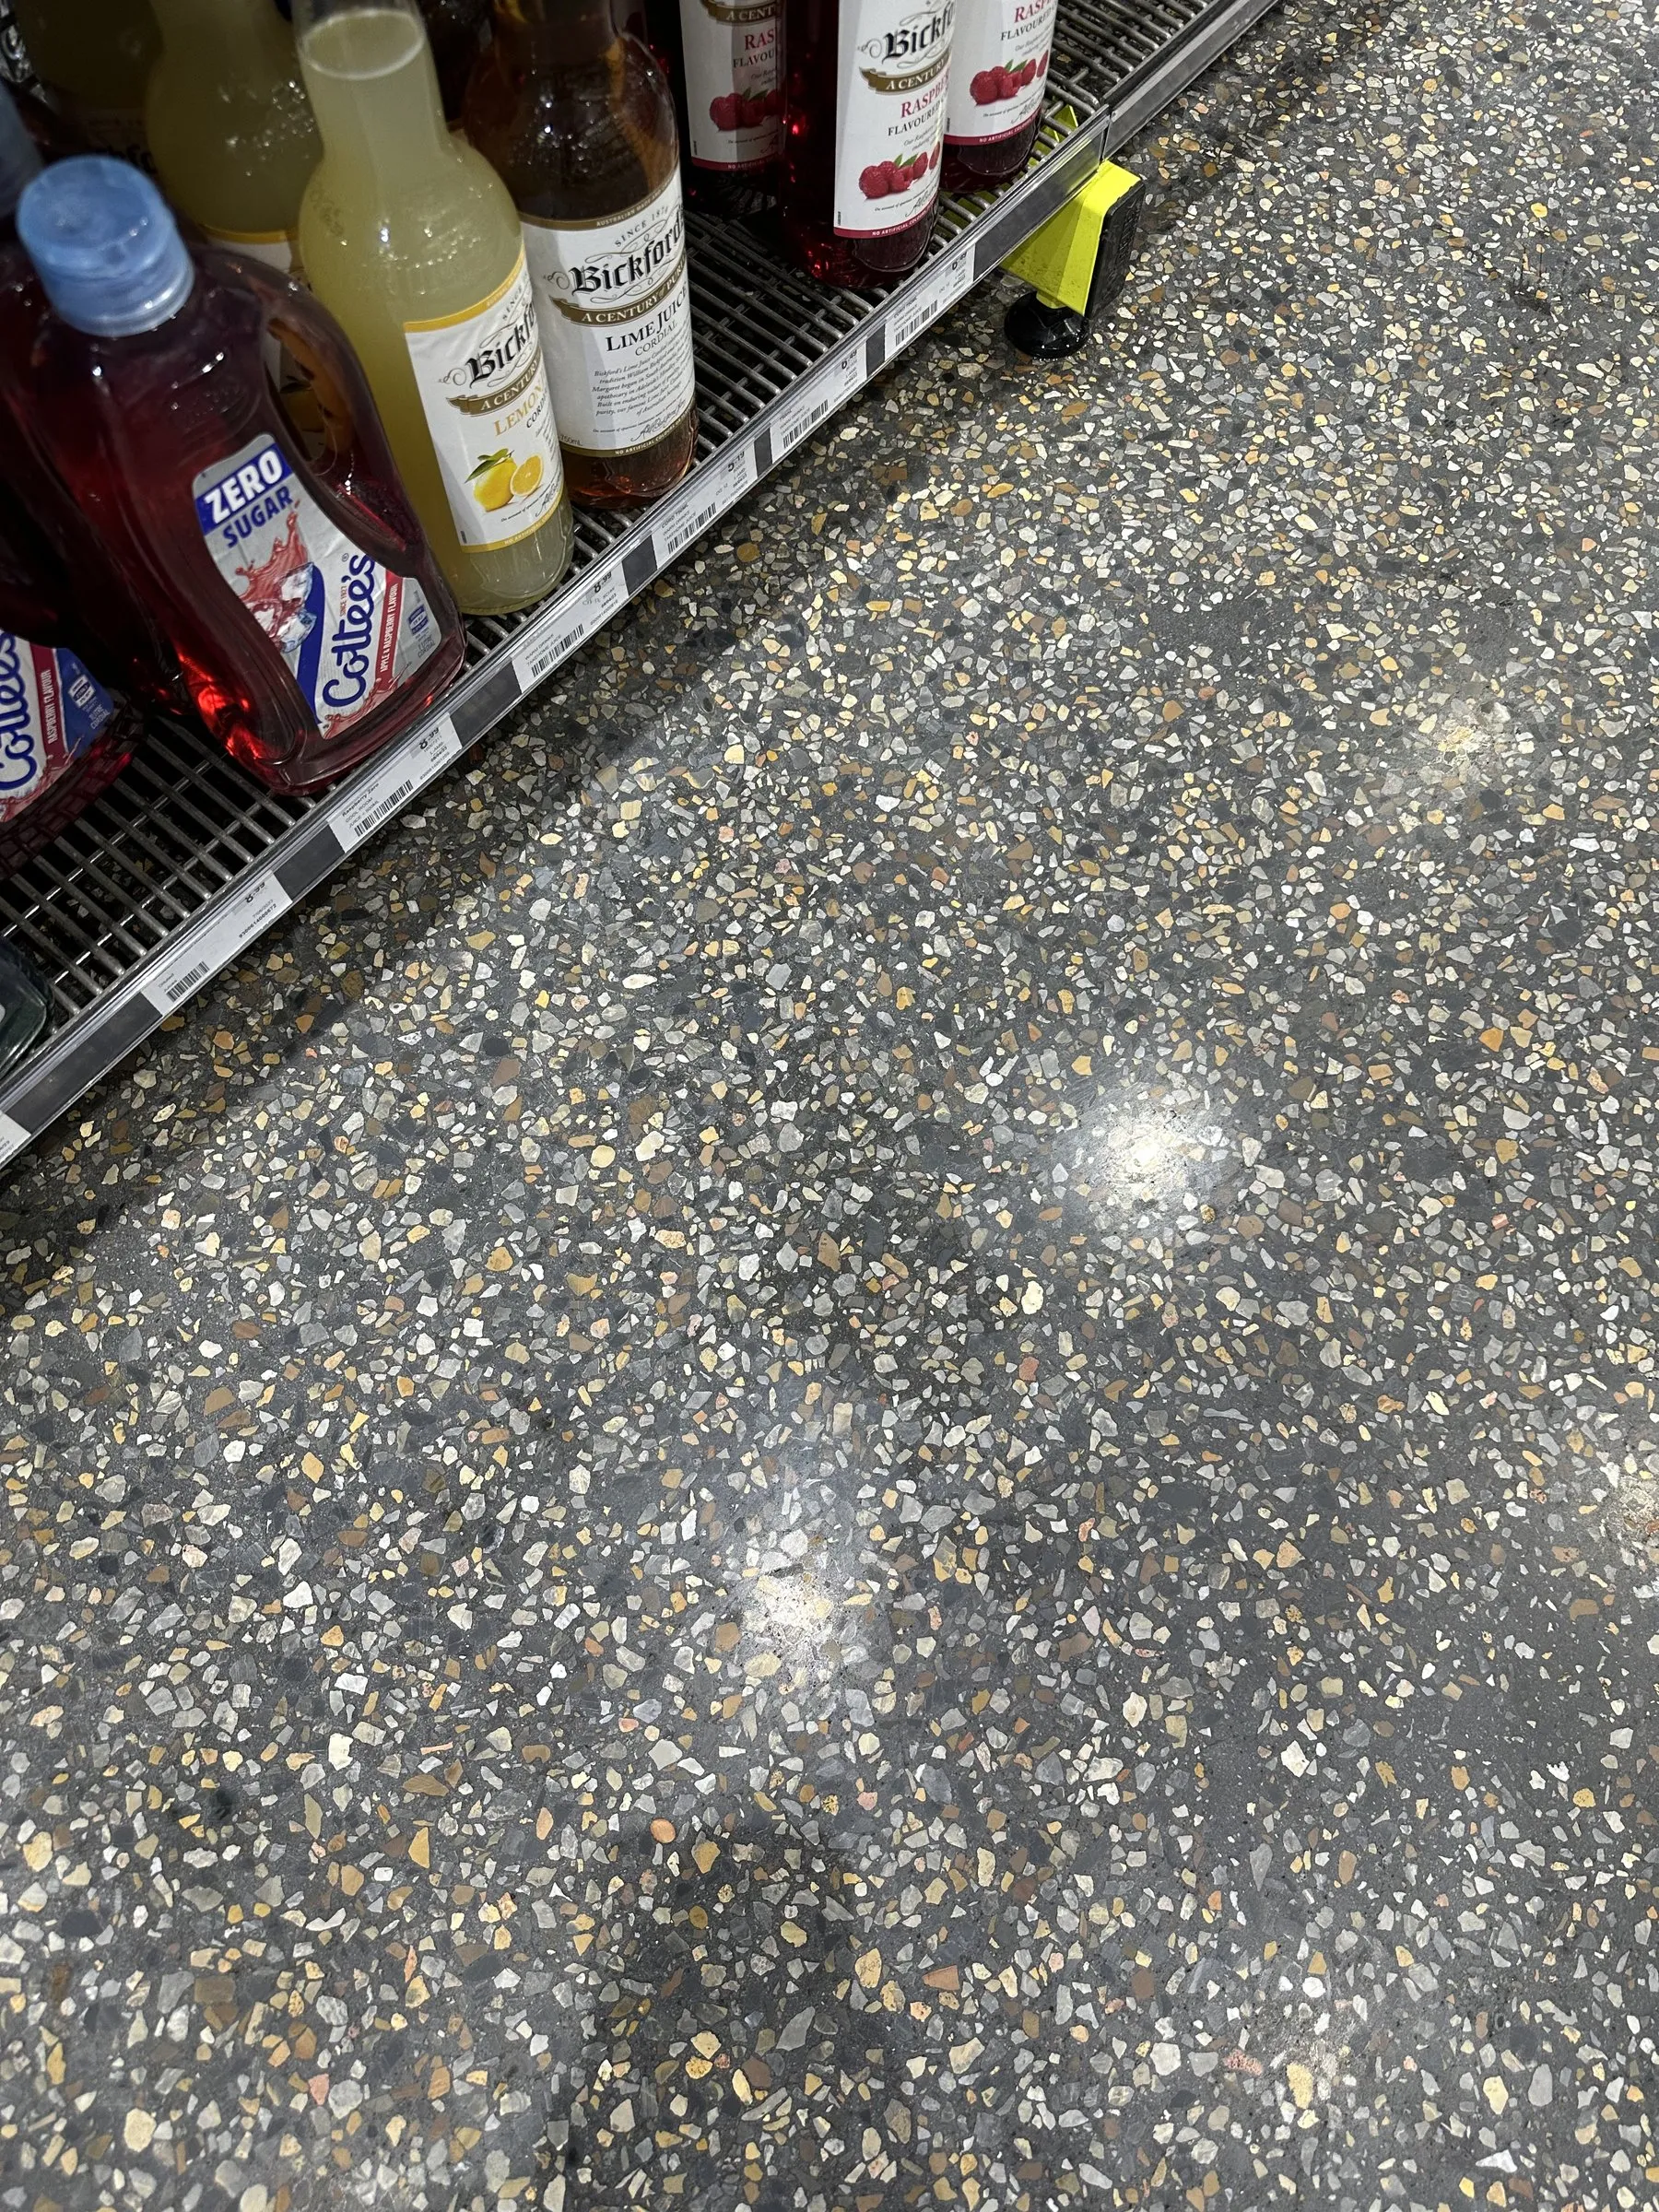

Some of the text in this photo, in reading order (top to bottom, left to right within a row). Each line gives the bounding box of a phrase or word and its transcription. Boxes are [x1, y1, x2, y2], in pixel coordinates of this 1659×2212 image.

[726, 10, 735, 20] A
[886, 80, 895, 90] A
[596, 209, 635, 227] AUSTRALIAN
[881, 223, 909, 235] ARTIFICIAL
[615, 219, 647, 247] SINCE
[582, 312, 592, 323] A
[595, 295, 659, 323] CENTURY
[606, 322, 654, 352] LIME
[635, 320, 678, 356] CORDIAL
[481, 400, 491, 411] A
[625, 439, 654, 454] ARTIFICIAL
[204, 451, 283, 524] ZERO
[223, 486, 293, 548] SUGAR
[594, 571, 612, 594] 8.99
[385, 582, 400, 614] FLAVOUR
[323, 554, 375, 707] Cottee's
[381, 612, 396, 650] RASPBERRY
[378, 653, 390, 673] APPLE
[41, 669, 58, 745] RASPBERRY FLAVOUR
[342, 794, 368, 817] Raspberry
